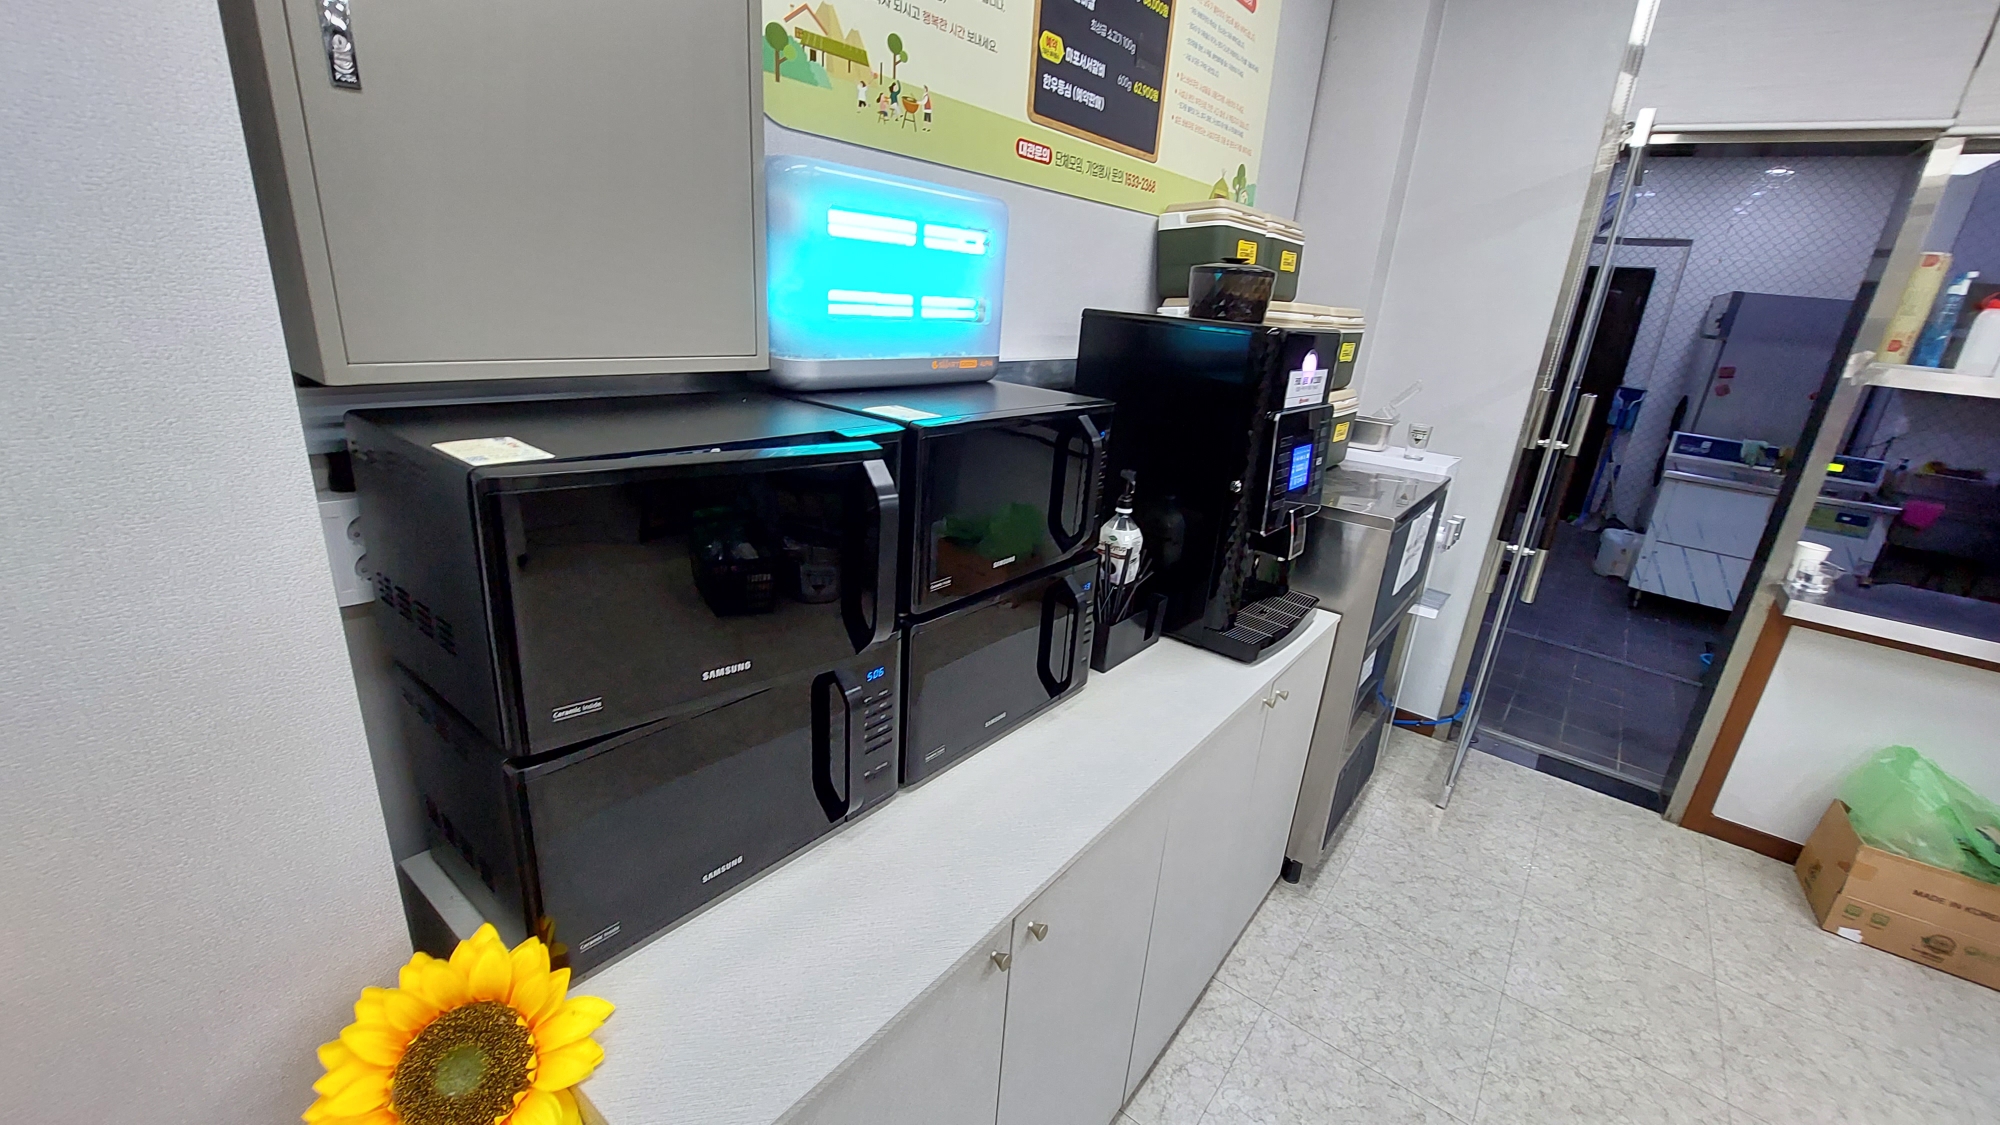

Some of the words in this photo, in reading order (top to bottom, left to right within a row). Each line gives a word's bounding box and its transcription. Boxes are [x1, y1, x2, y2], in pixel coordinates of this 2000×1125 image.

[893, 0, 920, 20] 되시고
[922, 10, 949, 32] 행복한
[949, 22, 965, 39] 시간
[967, 29, 998, 53] 보내세요.
[1042, 73, 1074, 99] 한우등심
[1018, 141, 1050, 162] 대관문의
[1085, 159, 1111, 181] 기업행사
[1111, 168, 1124, 184] 문의
[701, 660, 753, 682] SAMSUNG
[701, 855, 743, 884] SAMSUNG
[1912, 889, 1946, 904] MADE
[1948, 901, 1963, 910] IN
